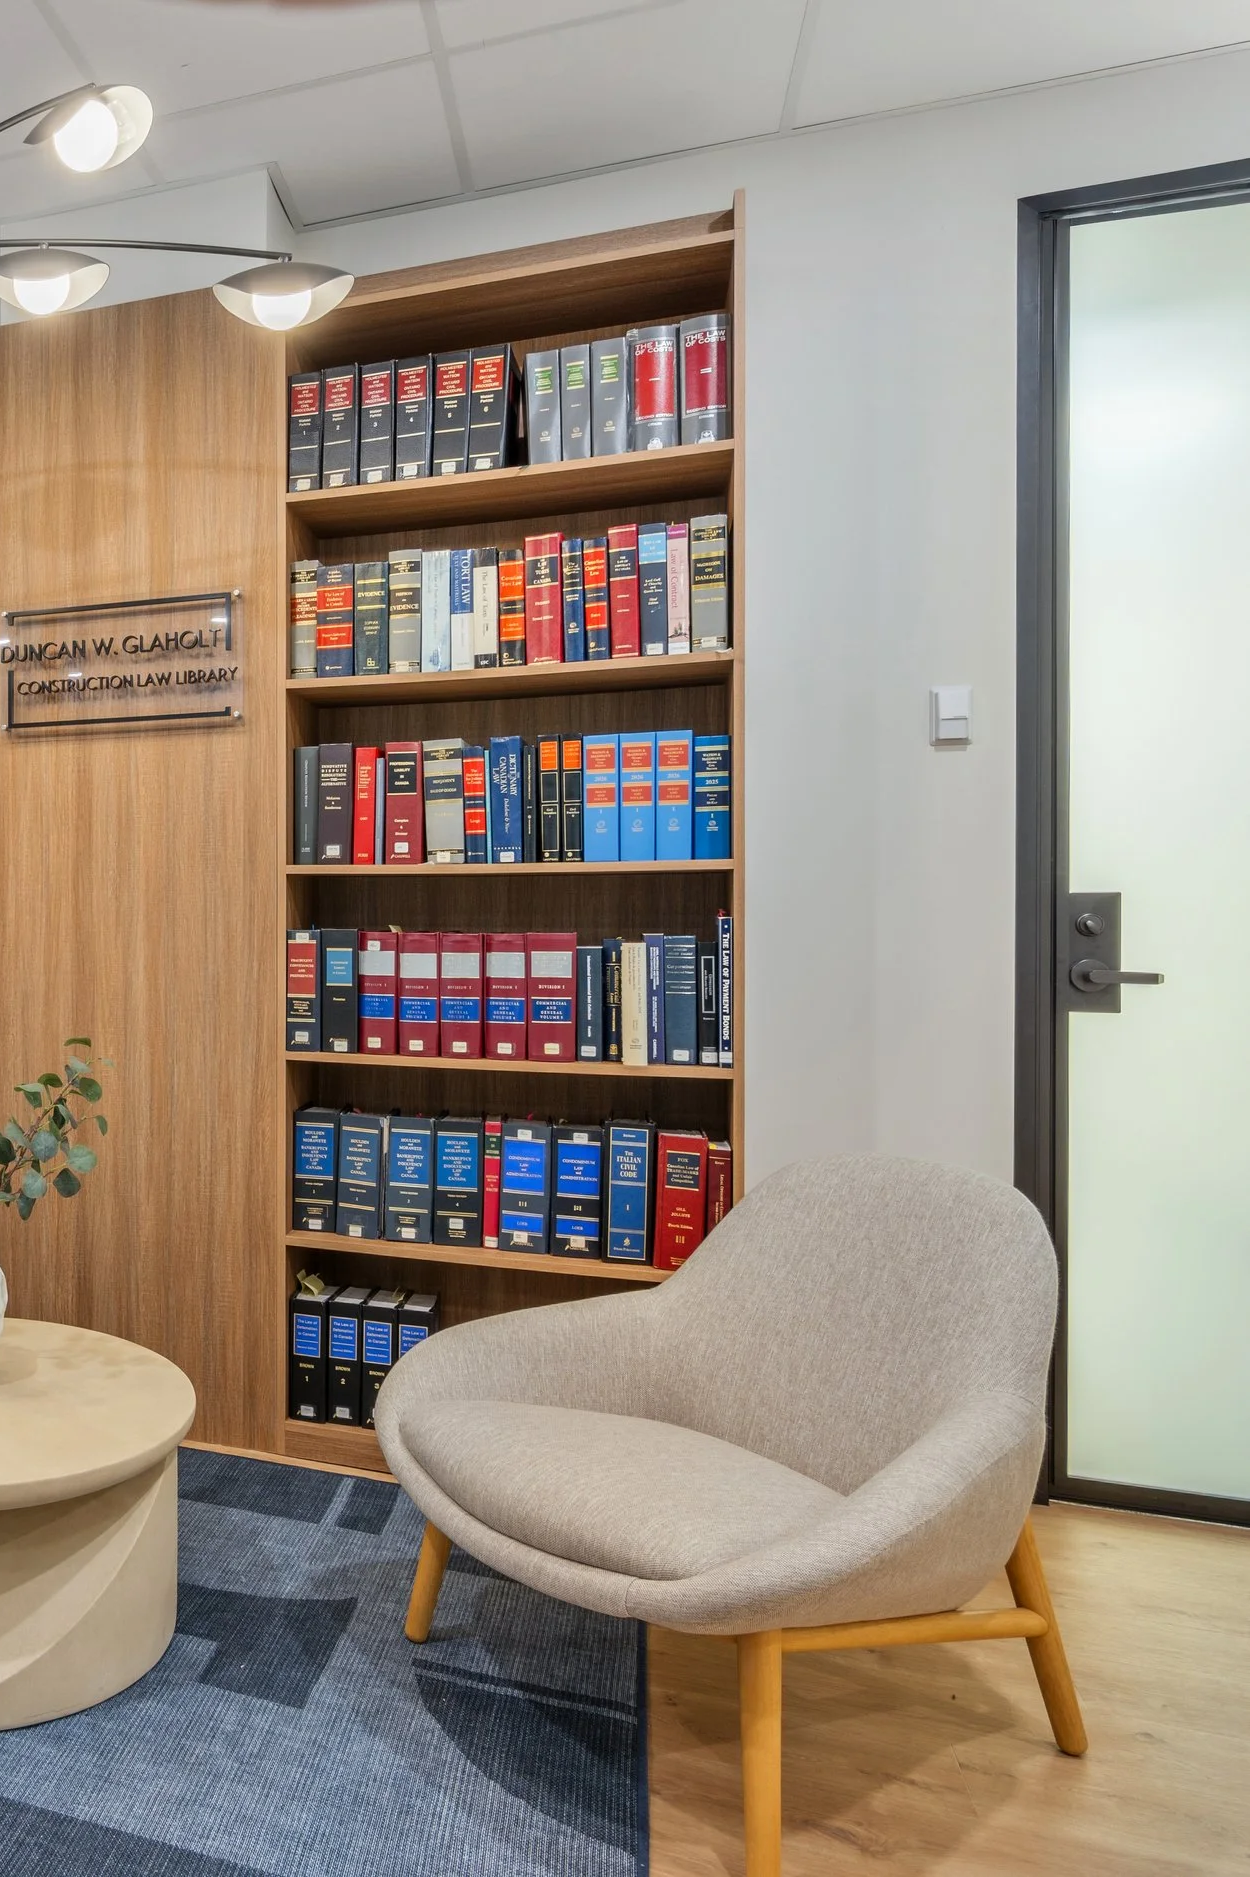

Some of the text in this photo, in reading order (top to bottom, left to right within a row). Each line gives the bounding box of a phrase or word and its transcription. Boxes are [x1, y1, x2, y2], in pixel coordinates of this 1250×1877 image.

[685, 333, 704, 342] THE
[461, 553, 470, 604] TORT LAW
[0, 629, 221, 663] DUNCAN W. GLAHOLT
[17, 667, 238, 695] CONSTRUCTION LAW LIBRARY
[499, 757, 507, 794] CANADIAN
[722, 970, 730, 978] OF
